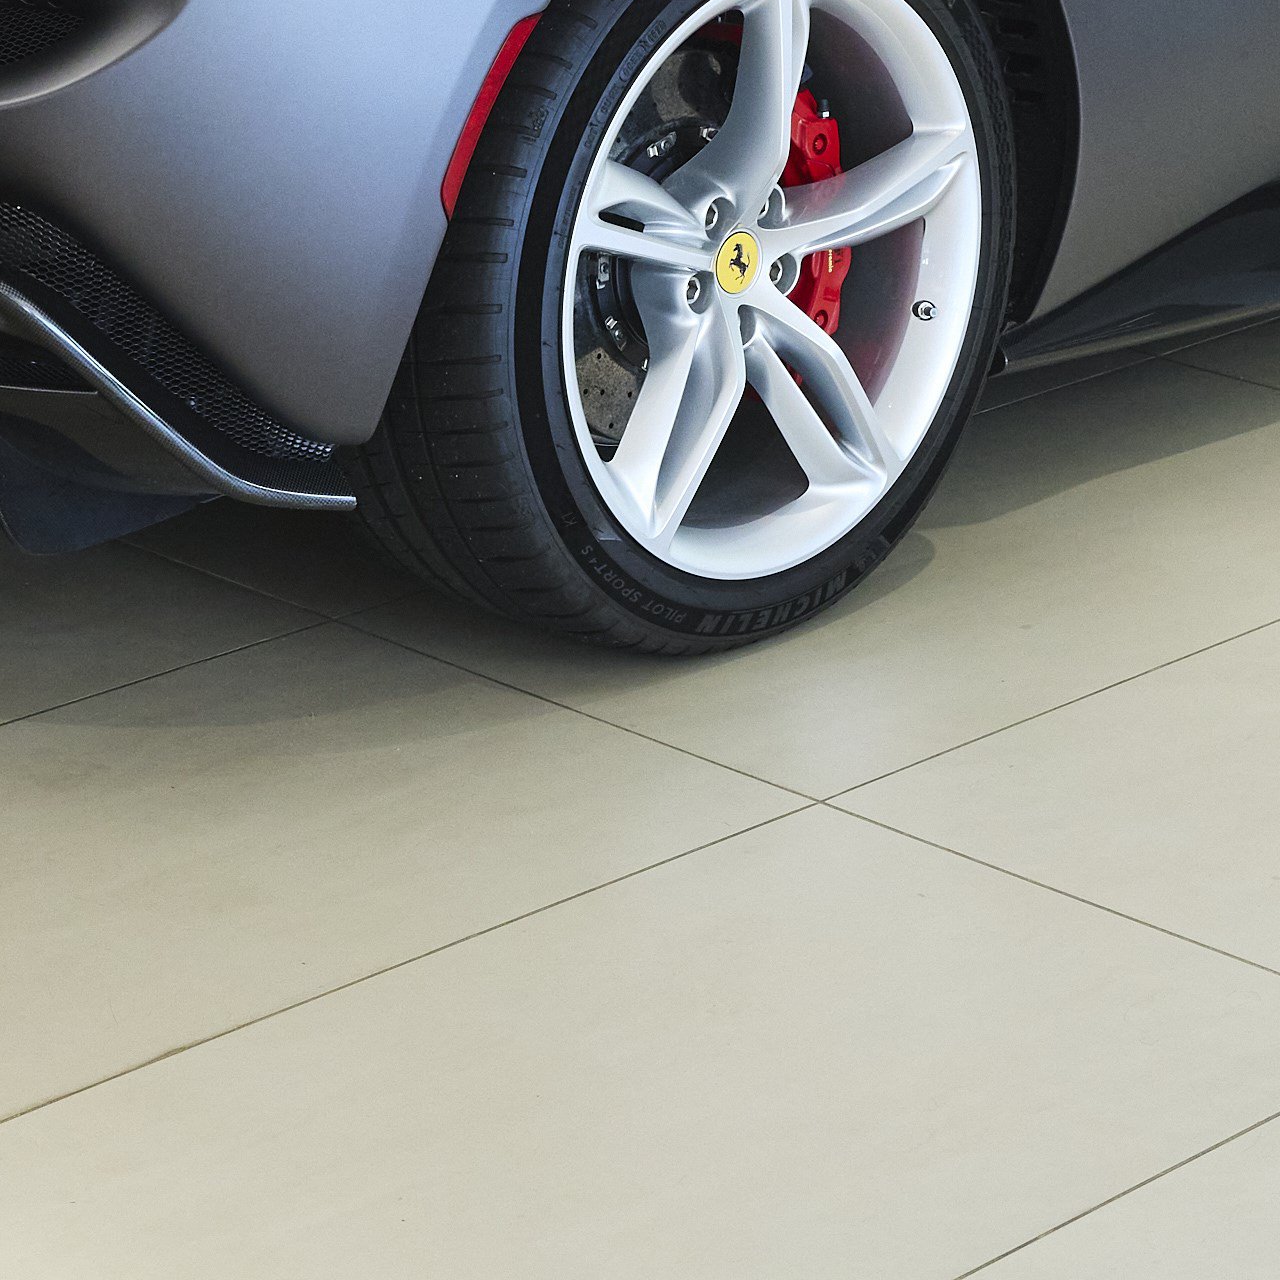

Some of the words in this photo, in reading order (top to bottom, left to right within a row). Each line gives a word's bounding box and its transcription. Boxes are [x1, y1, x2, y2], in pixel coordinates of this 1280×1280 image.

[593, 564, 642, 602] SPORT
[695, 570, 847, 634] MICHELIN
[640, 599, 688, 623] PILOT
